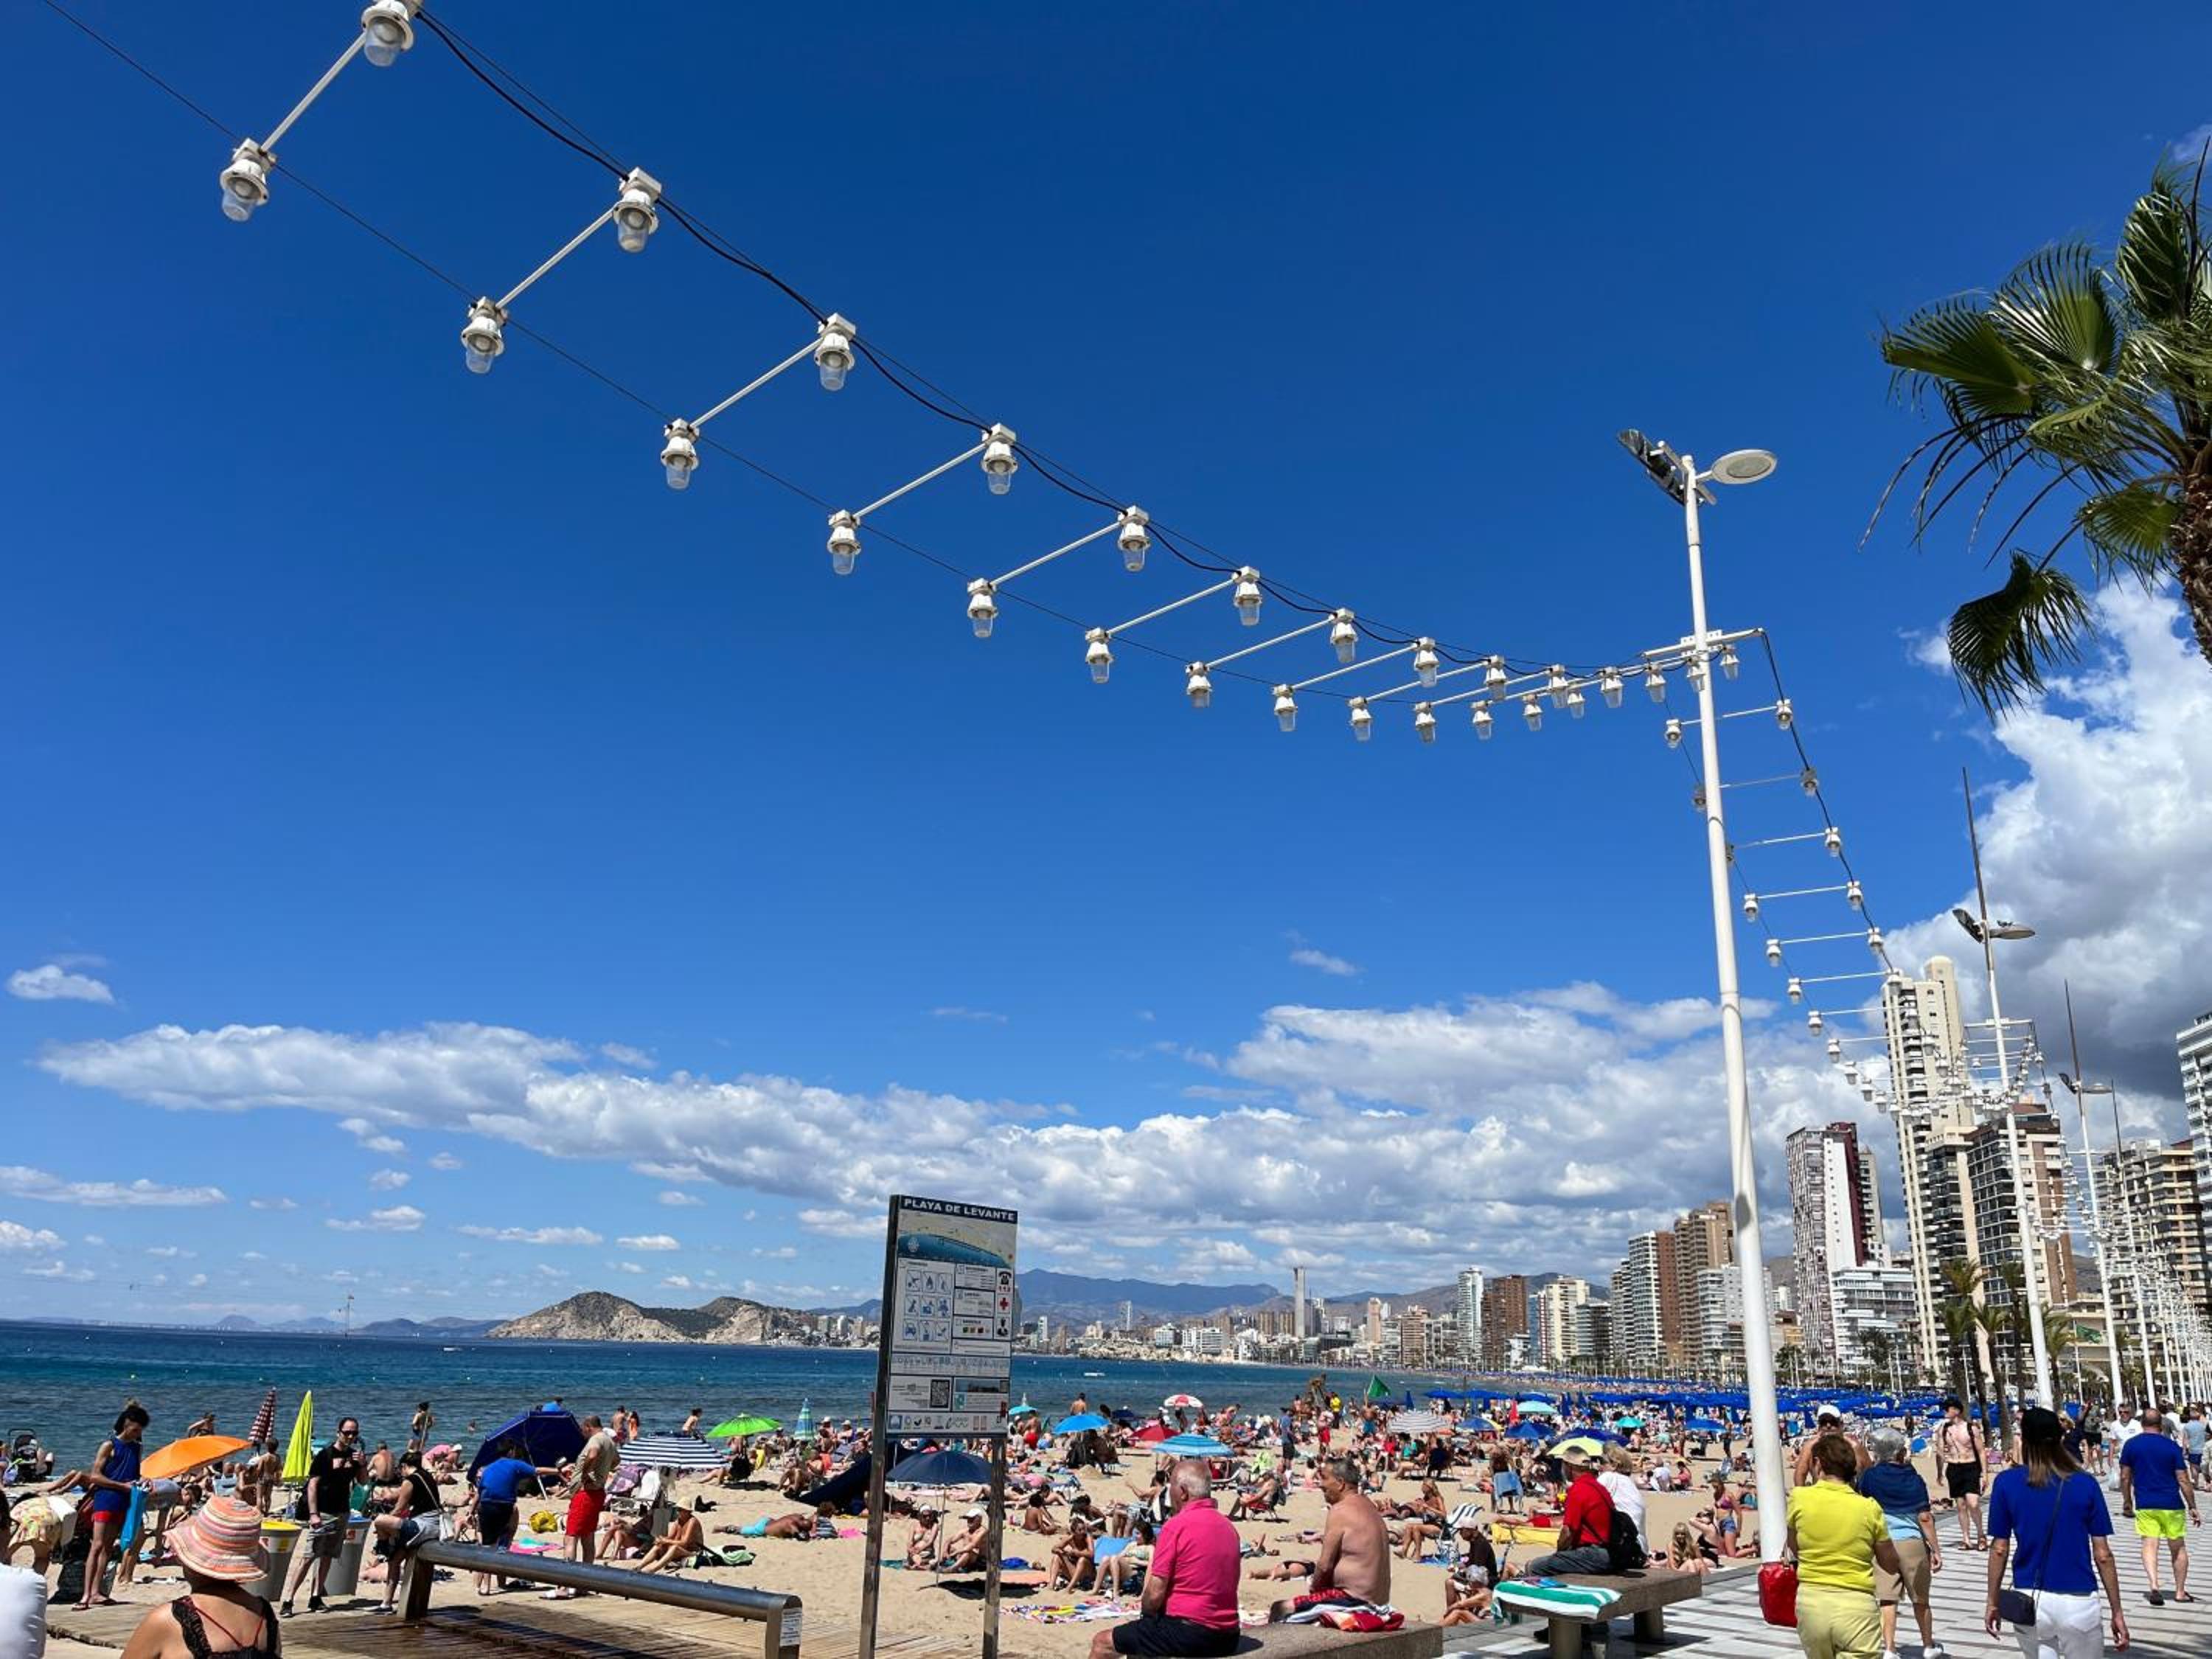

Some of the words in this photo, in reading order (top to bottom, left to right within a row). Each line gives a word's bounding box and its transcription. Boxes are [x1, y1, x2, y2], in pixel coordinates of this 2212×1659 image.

[904, 1199, 942, 1211] PLAYA
[945, 1204, 961, 1214] DE
[964, 1207, 1015, 1221] LEVANTE
